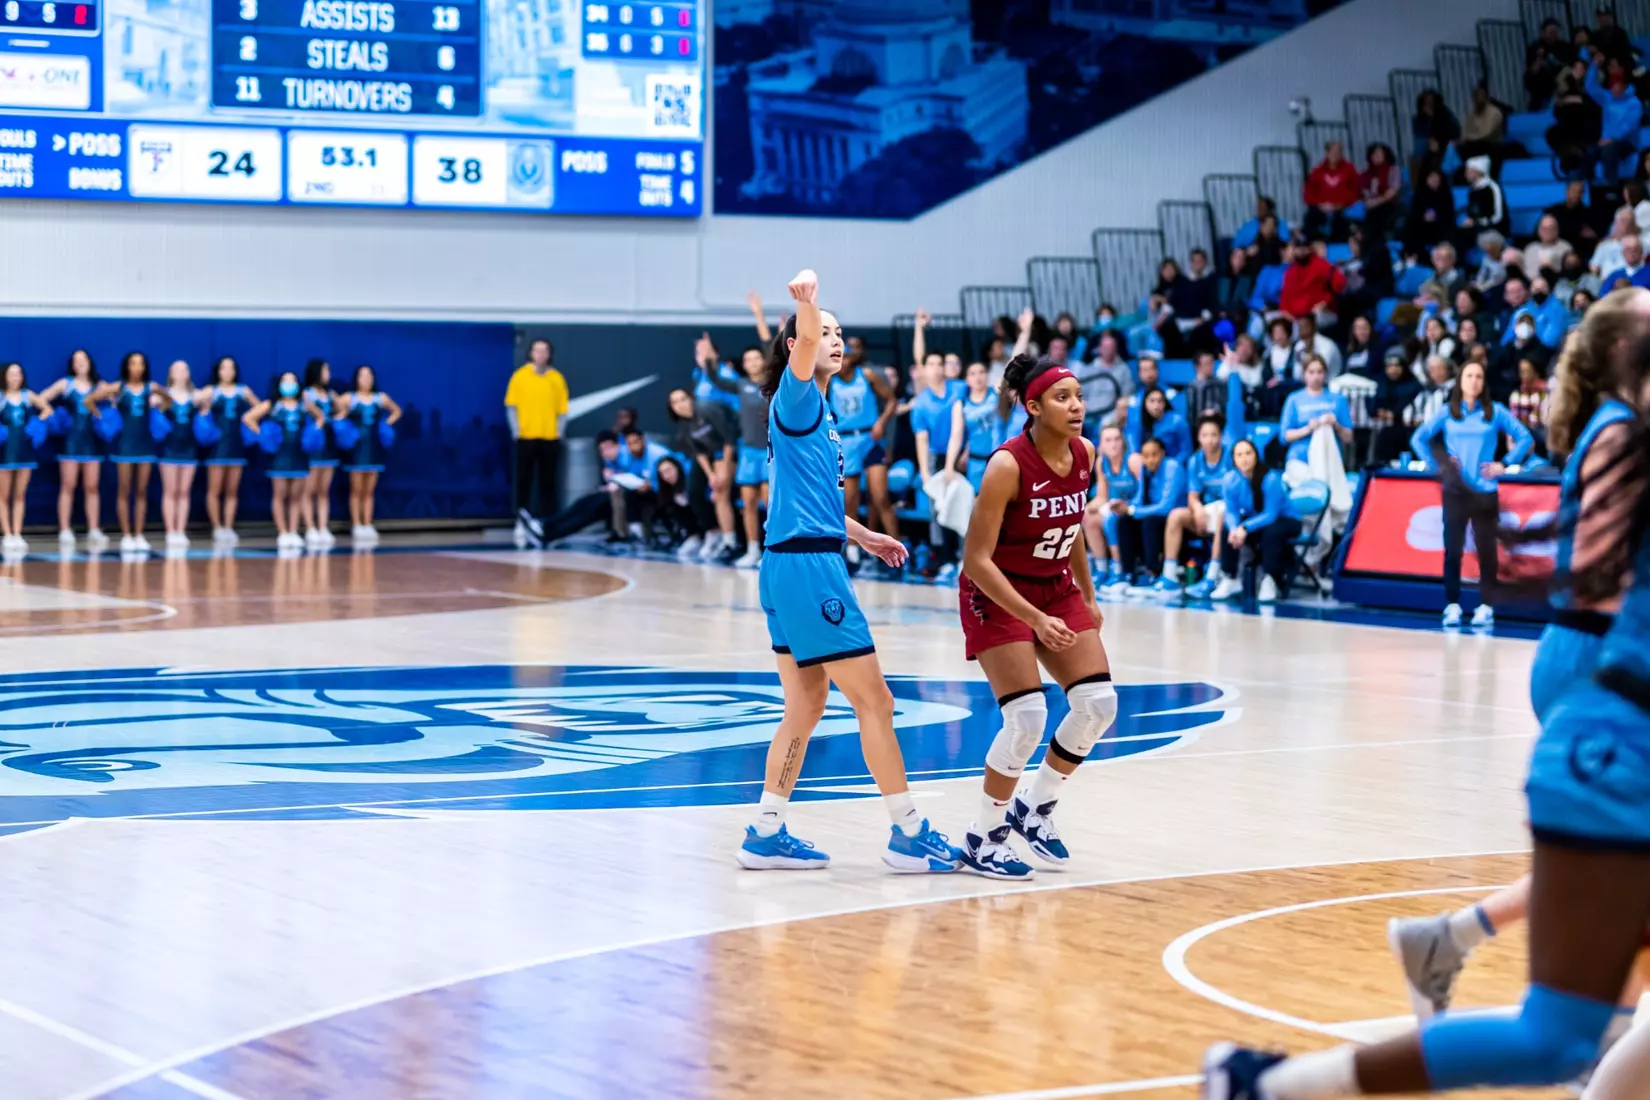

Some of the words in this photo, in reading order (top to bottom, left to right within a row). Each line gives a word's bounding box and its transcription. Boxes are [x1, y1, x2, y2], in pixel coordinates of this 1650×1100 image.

[300, 0, 395, 32] ASSISTS
[239, 36, 257, 61] 2
[307, 38, 388, 72] STEALS
[236, 76, 261, 101] 11
[283, 77, 412, 112] TURNOVERS
[436, 84, 455, 109] 4
[69, 132, 121, 157] POSS
[321, 145, 376, 168] 53.1
[208, 150, 256, 177] 24
[437, 157, 482, 184] 38
[681, 150, 694, 175] 5
[680, 179, 694, 205] 4
[1033, 523, 1081, 560] 22
